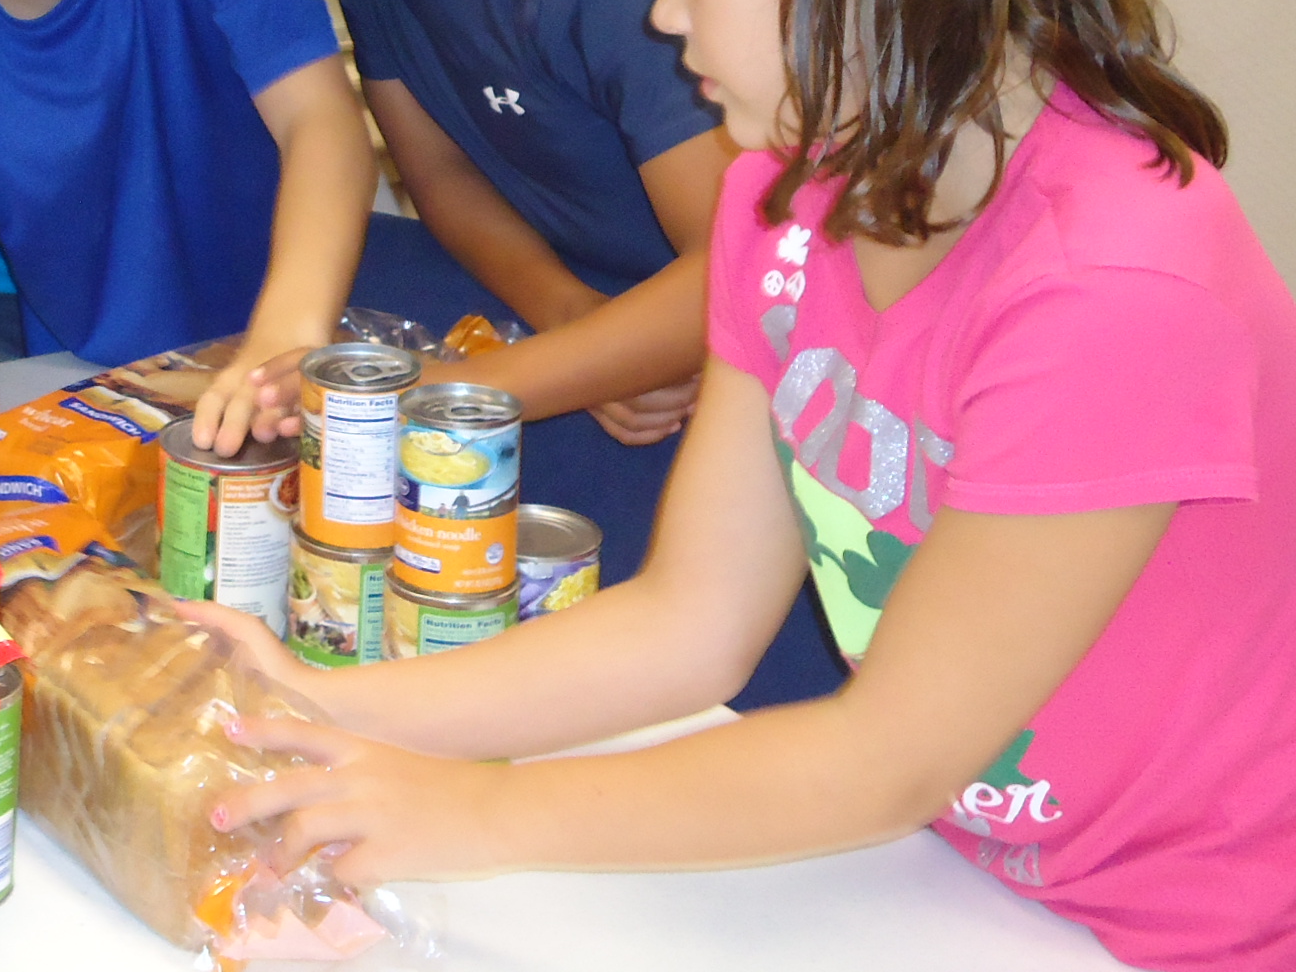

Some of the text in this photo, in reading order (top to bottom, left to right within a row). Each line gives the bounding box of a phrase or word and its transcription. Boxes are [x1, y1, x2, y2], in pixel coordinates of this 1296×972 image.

[369, 399, 394, 407] Facts
[68, 401, 142, 437] SANDWICH
[436, 527, 482, 542] noodle
[425, 618, 502, 629] Nutrition Facts
